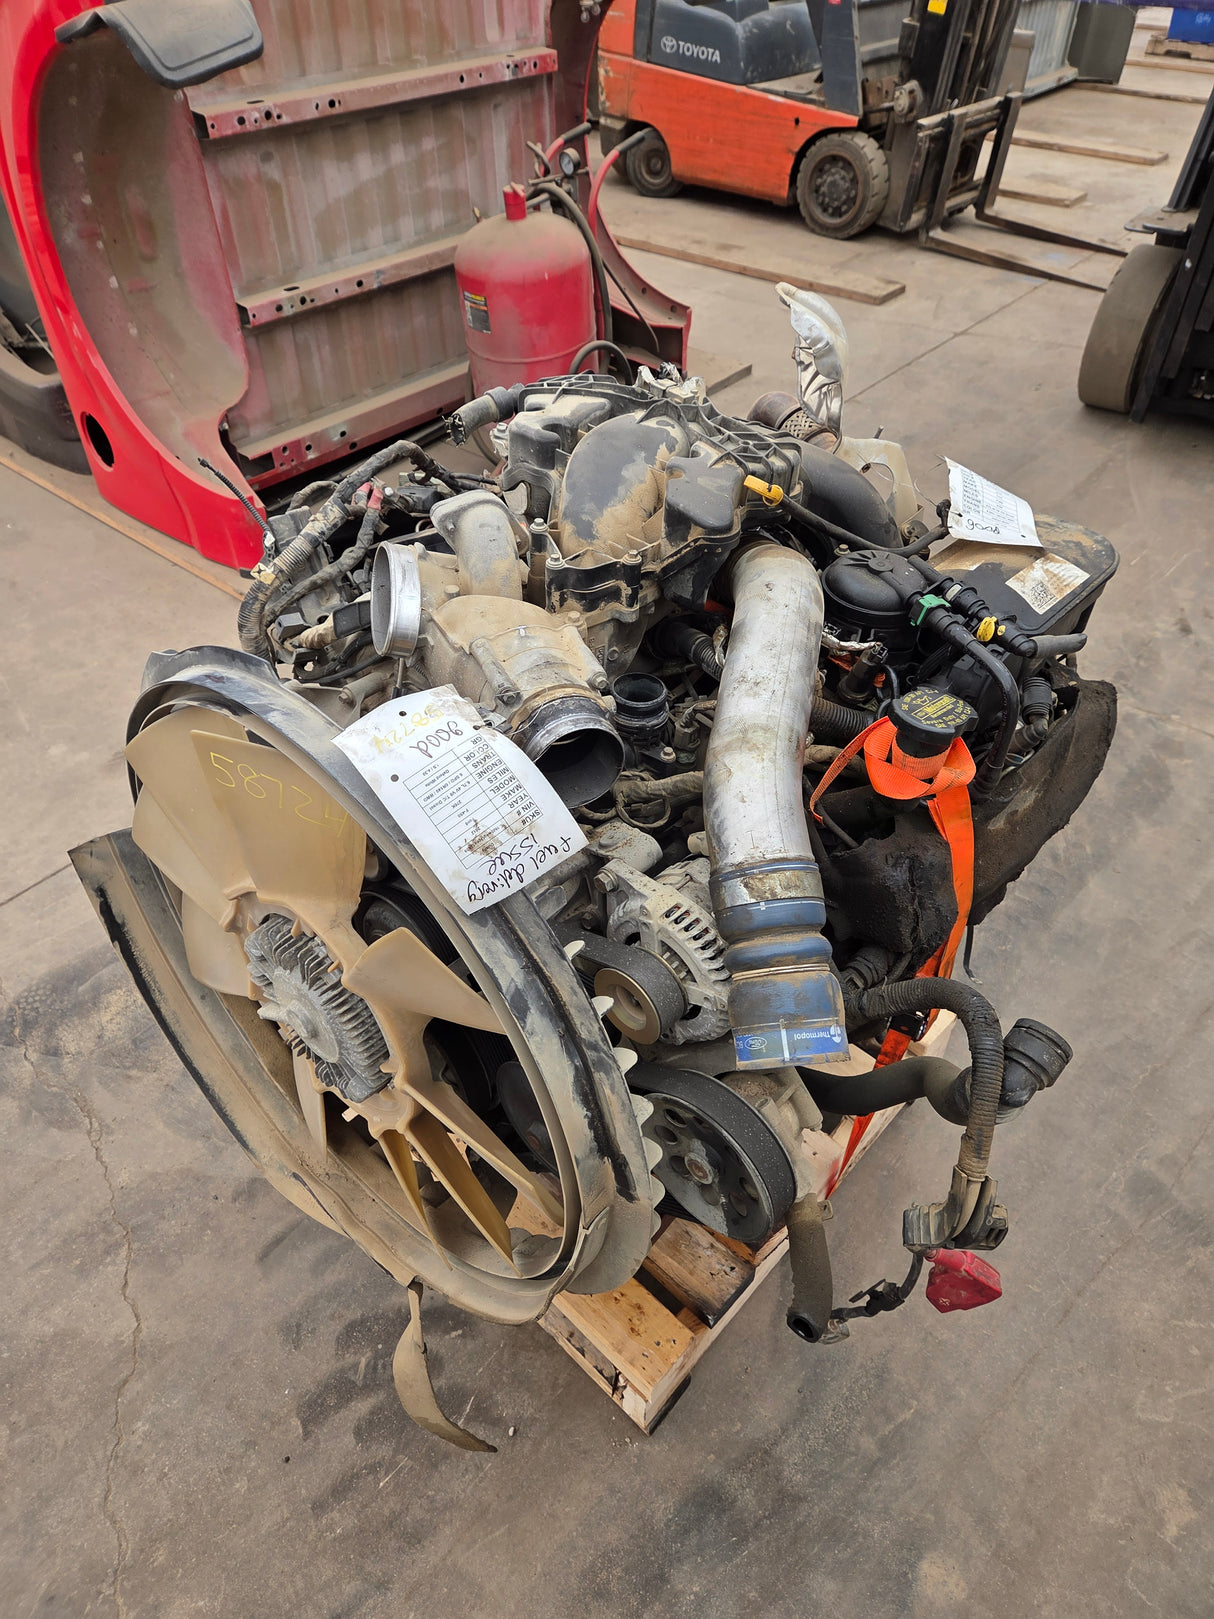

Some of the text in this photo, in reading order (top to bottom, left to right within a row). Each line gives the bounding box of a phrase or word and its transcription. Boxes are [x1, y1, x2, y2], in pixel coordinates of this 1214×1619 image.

[678, 41, 721, 64] TOYOTA
[408, 720, 463, 759] good
[469, 734, 482, 746] GR
[462, 742, 489, 762] COLOR
[470, 749, 496, 769] TRANS
[474, 757, 502, 779] ENGINE
[485, 765, 509, 784] MILES
[210, 751, 349, 838] 58724
[488, 774, 516, 795] MODEL
[499, 782, 522, 801] MAKE
[428, 799, 443, 810] Diesel
[507, 792, 529, 809] YEAR
[519, 799, 534, 813] VIN
[520, 808, 540, 826] SKU#
[476, 832, 540, 876] issue
[530, 836, 571, 870] fuel
[467, 863, 525, 902] delivery
[794, 1031, 831, 1041] Thermopol
